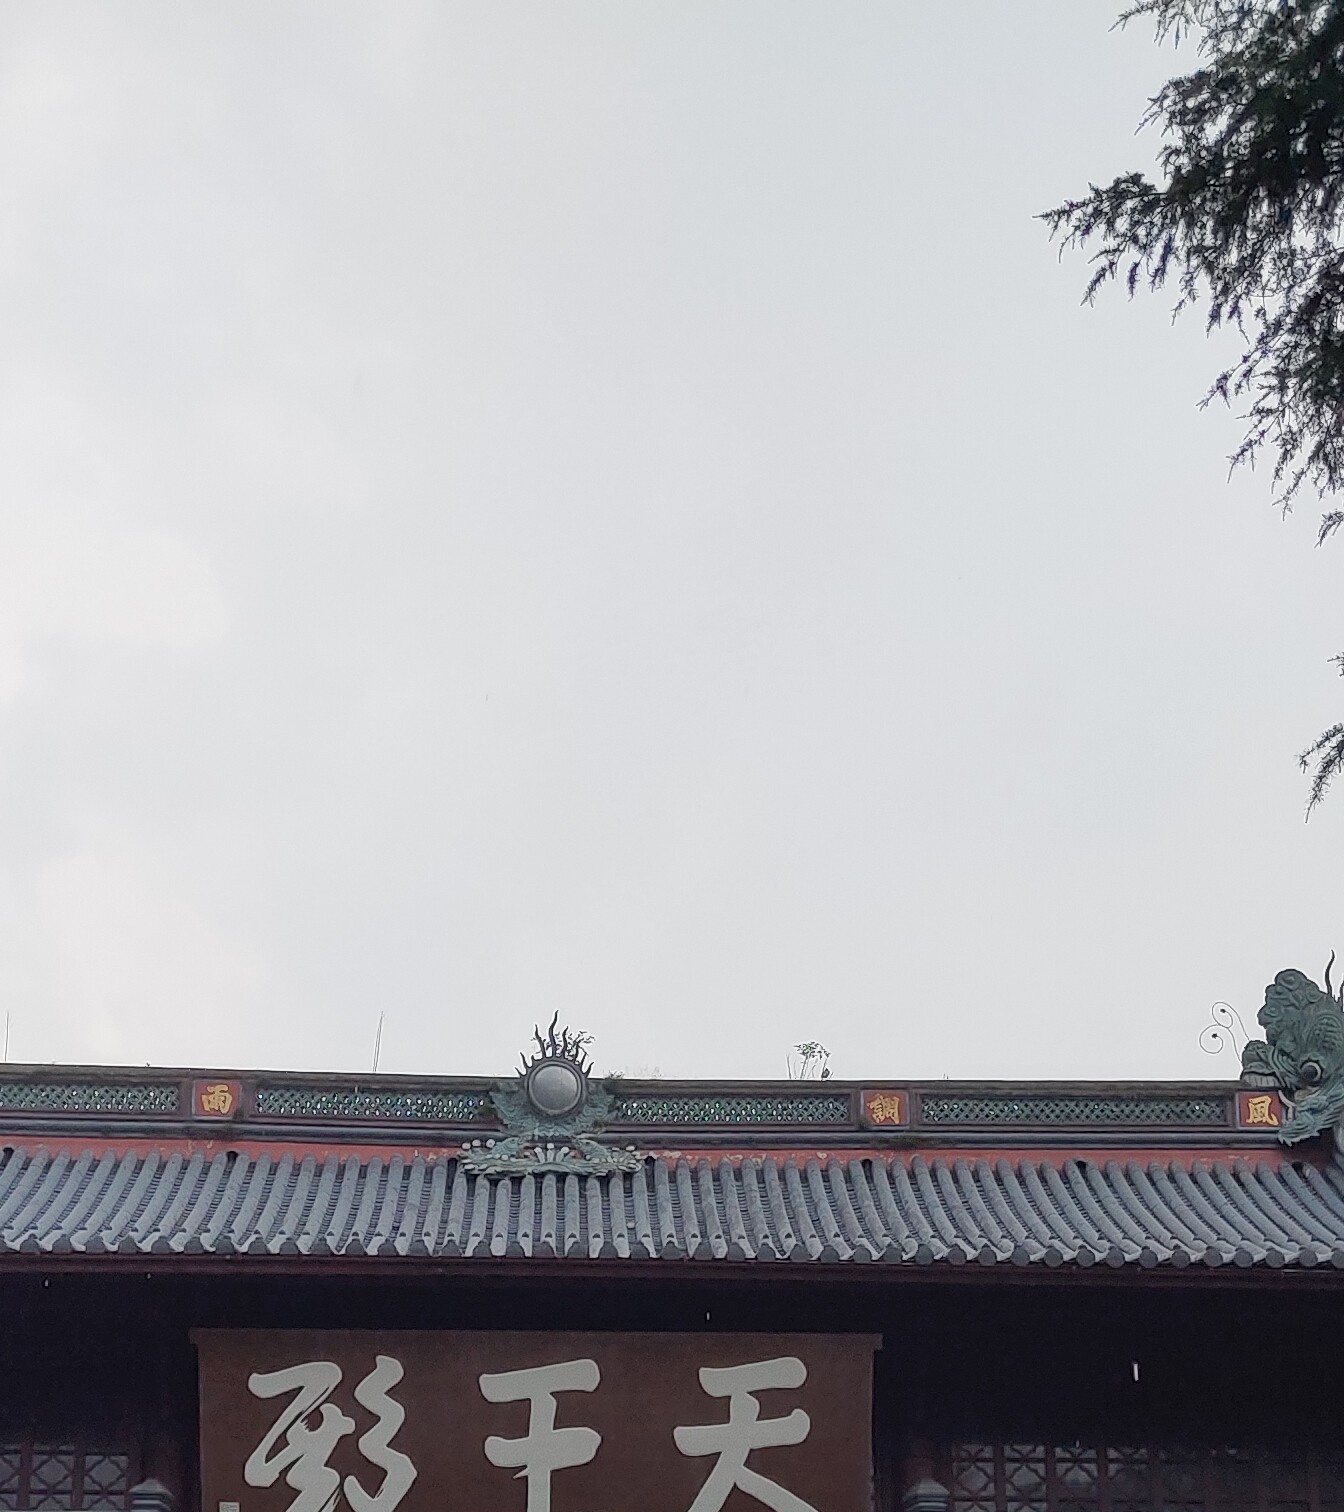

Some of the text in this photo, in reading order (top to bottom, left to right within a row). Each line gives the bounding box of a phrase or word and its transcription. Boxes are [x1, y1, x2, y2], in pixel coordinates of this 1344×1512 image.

[201, 1084, 233, 1114] 雨
[866, 1093, 900, 1124] 調
[1246, 1095, 1278, 1126] 風
